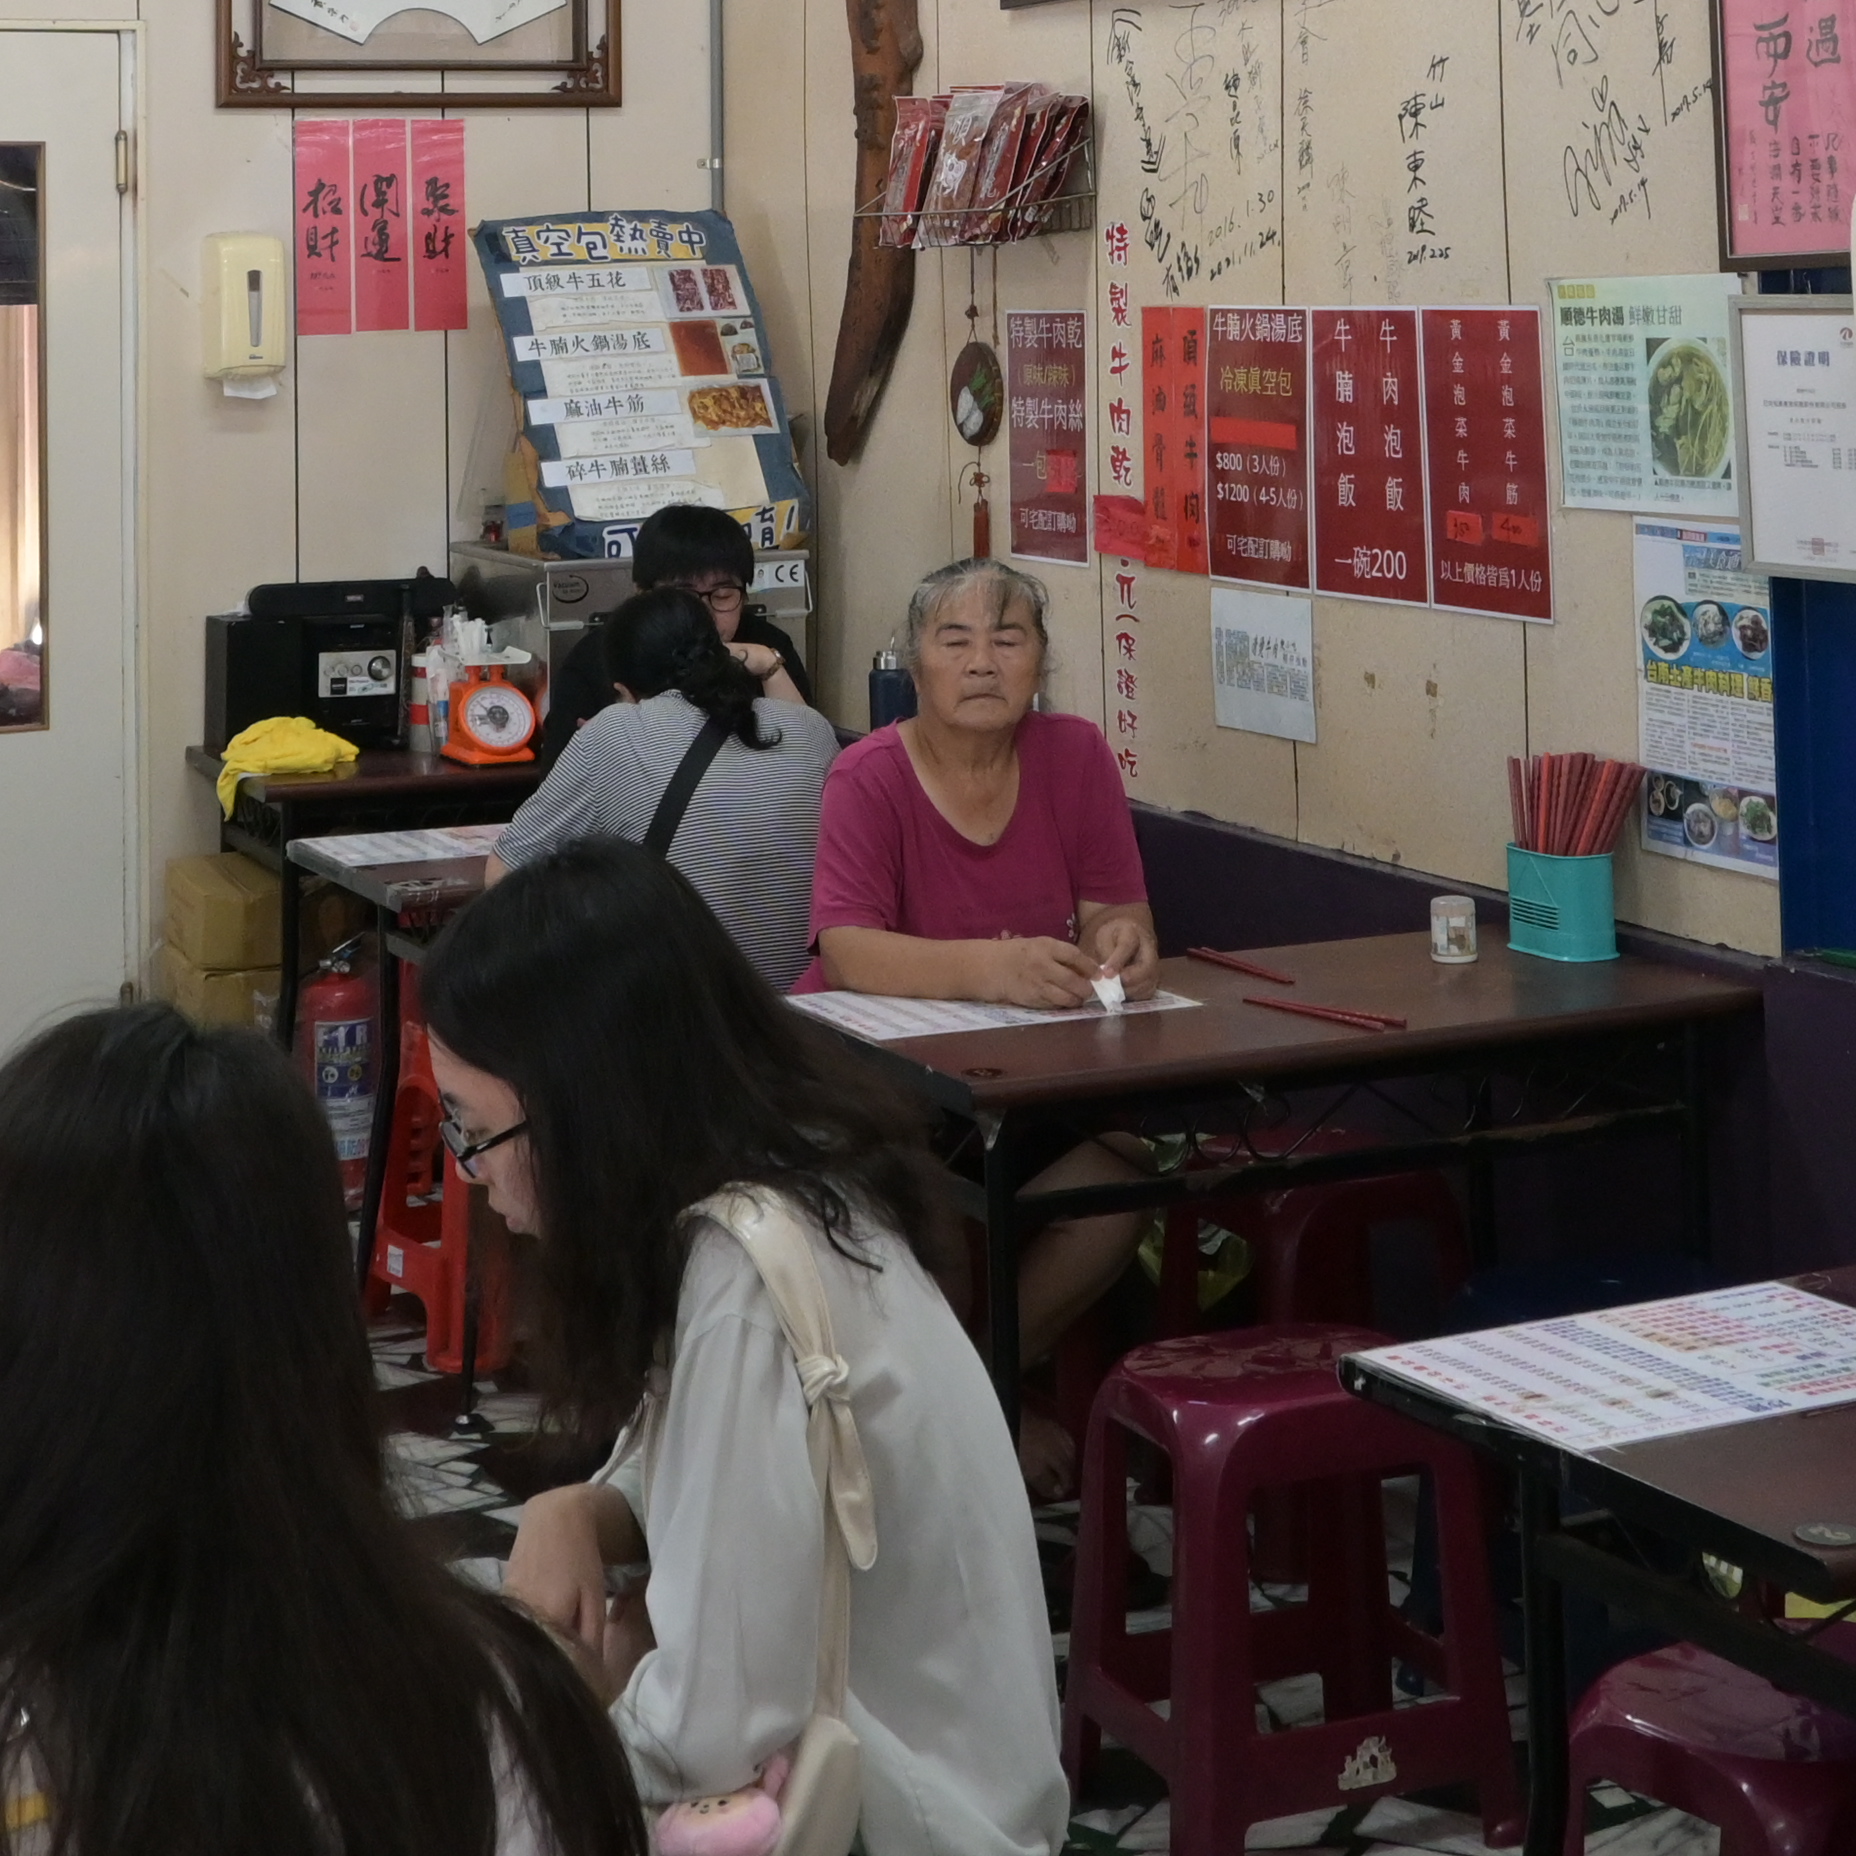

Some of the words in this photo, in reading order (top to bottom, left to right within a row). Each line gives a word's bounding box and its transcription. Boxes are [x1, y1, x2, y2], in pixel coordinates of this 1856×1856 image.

[503, 214, 706, 264] 真空包熱賣中
[525, 271, 627, 293] 頂級牛五花
[528, 331, 651, 357] 牛腩火鍋湯底
[1010, 317, 1082, 349] 特製牛肉乾
[1213, 312, 1303, 345] 牛腩火鍋湯底
[1106, 223, 1132, 488] 特製牛肉乾
[564, 394, 645, 418] 麻油牛筋
[1012, 396, 1083, 432] 特製牛肉絲
[1334, 318, 1356, 508] 牛腩泡飯
[1379, 318, 1404, 511] 牛肉泡飯
[1449, 319, 1470, 504] 黃金泡菜牛肉
[1497, 319, 1519, 505] 黃金泡菜牛筋
[1334, 545, 1407, 580] 一碗200
